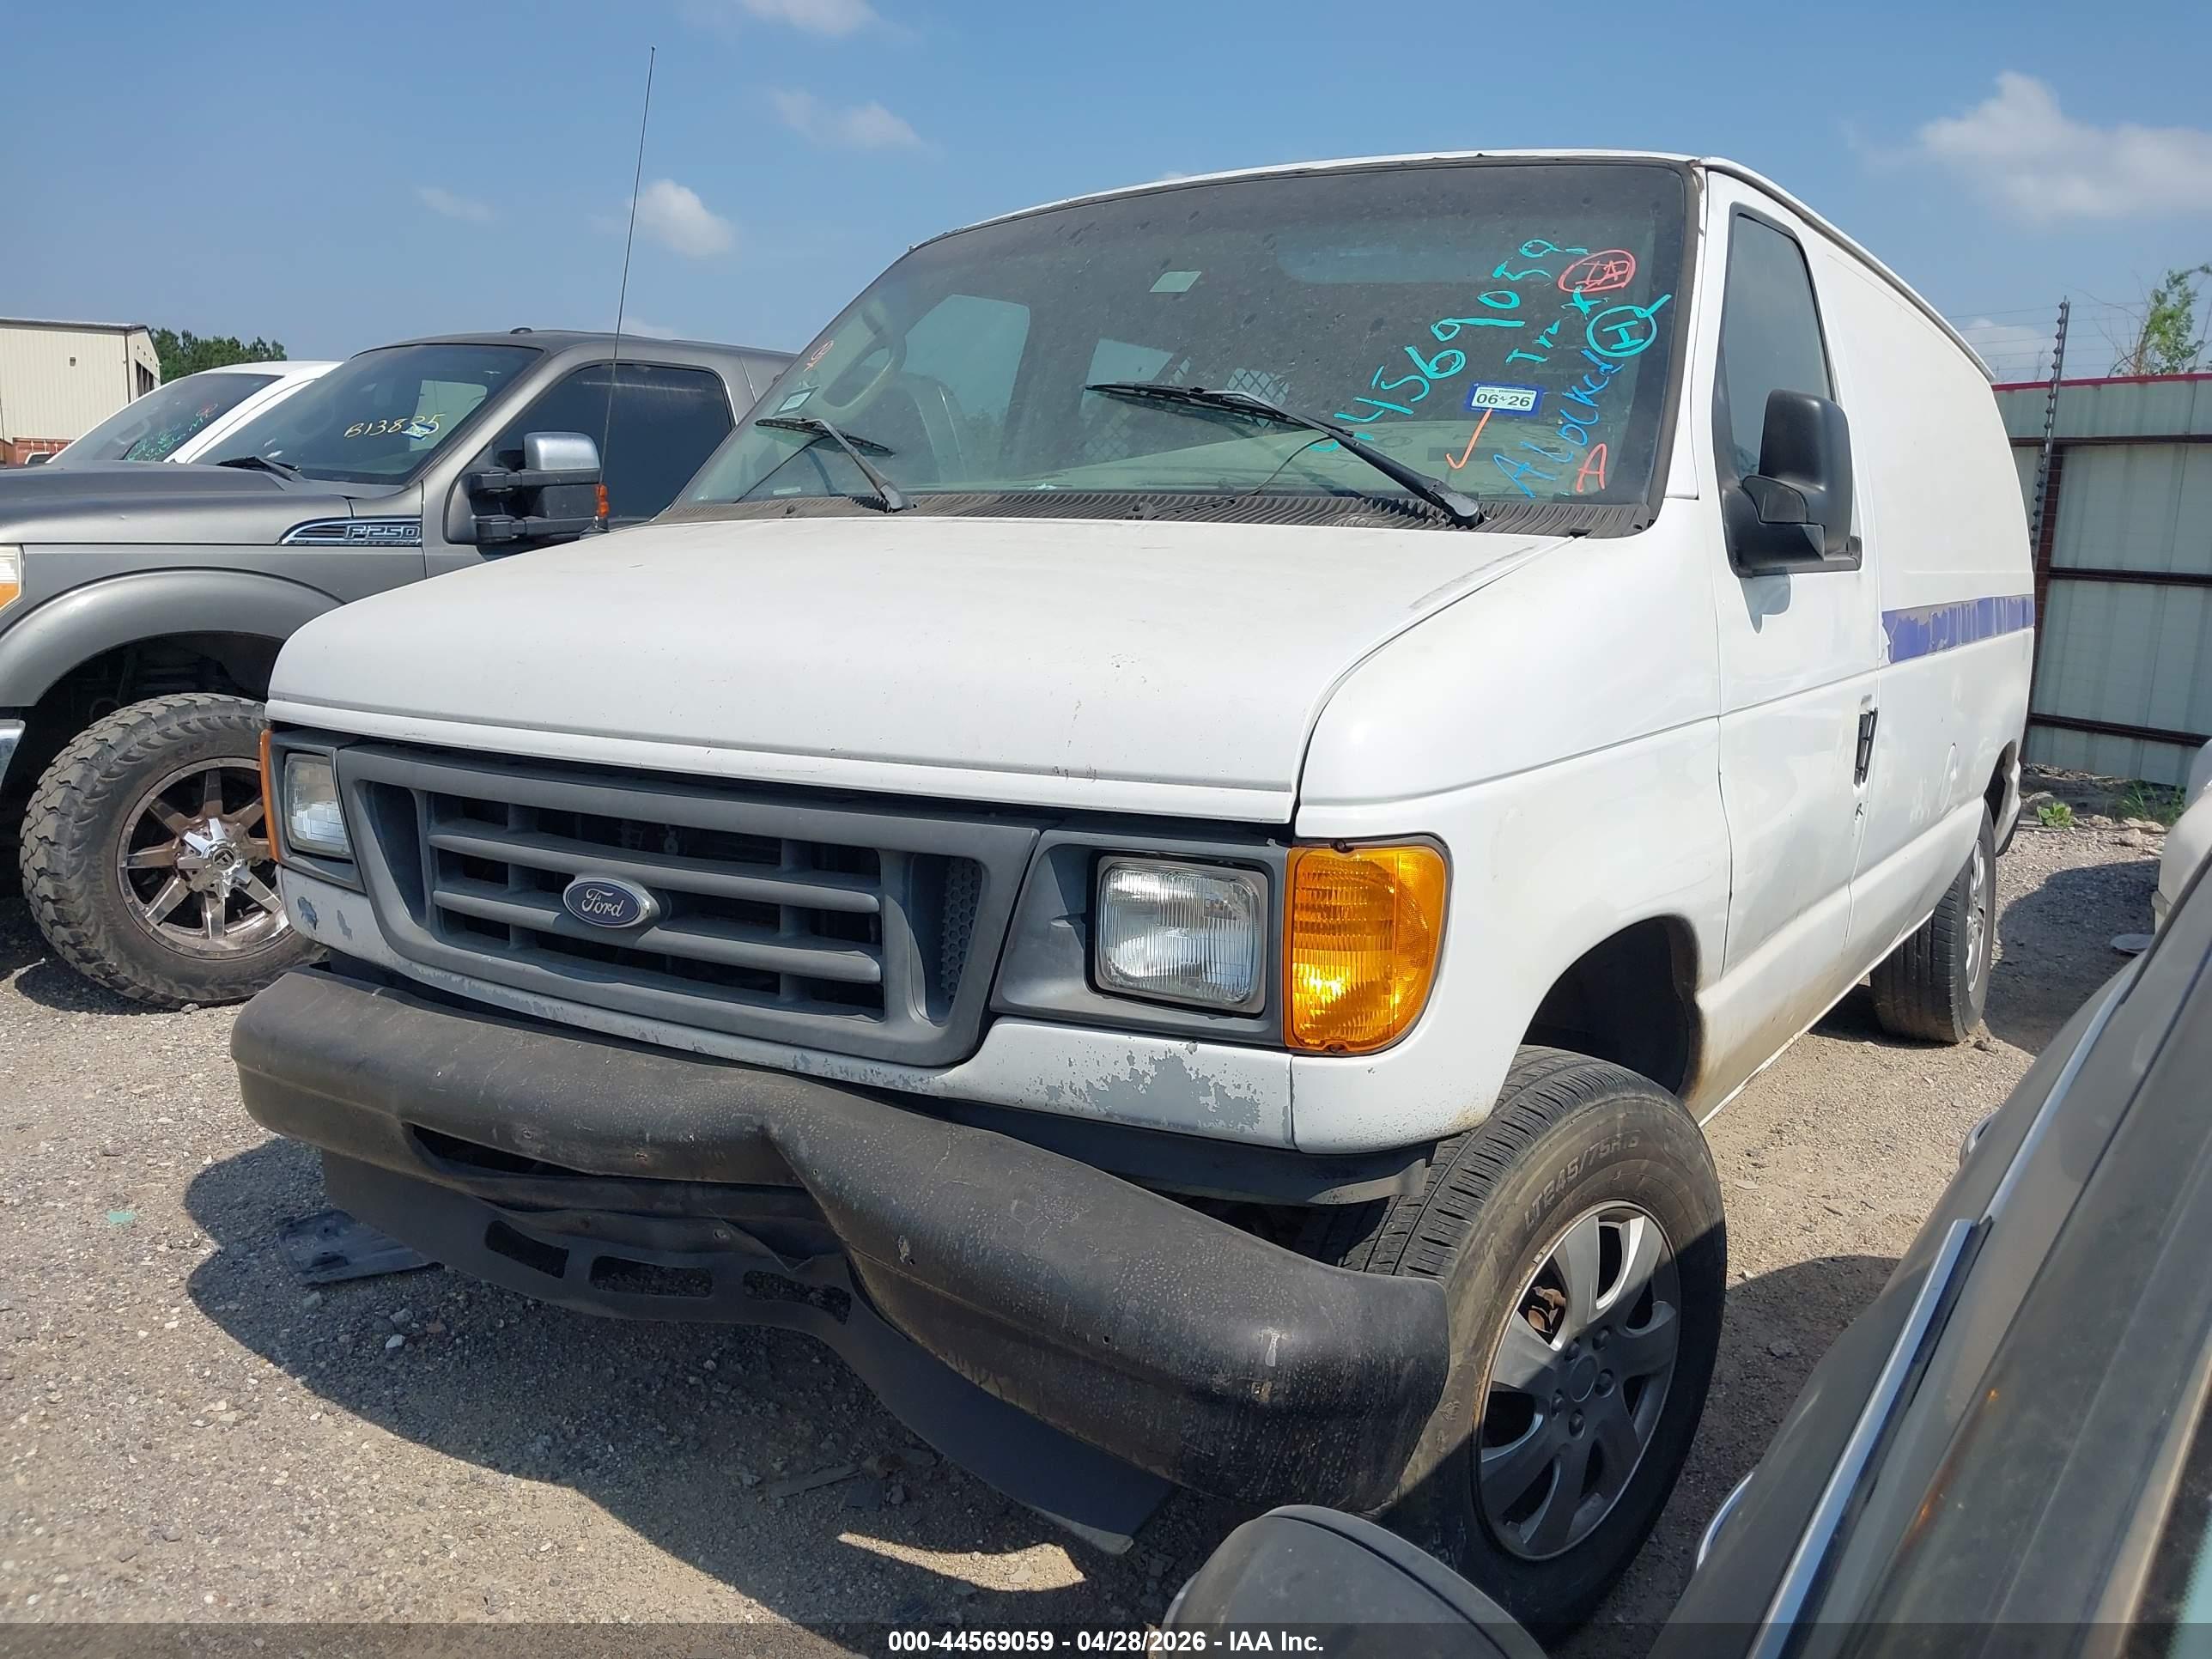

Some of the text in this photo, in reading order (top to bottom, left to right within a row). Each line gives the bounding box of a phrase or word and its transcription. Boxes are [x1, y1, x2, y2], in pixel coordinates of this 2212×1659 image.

[1476, 393, 1532, 408] 06 26
[581, 887, 626, 918] Ford
